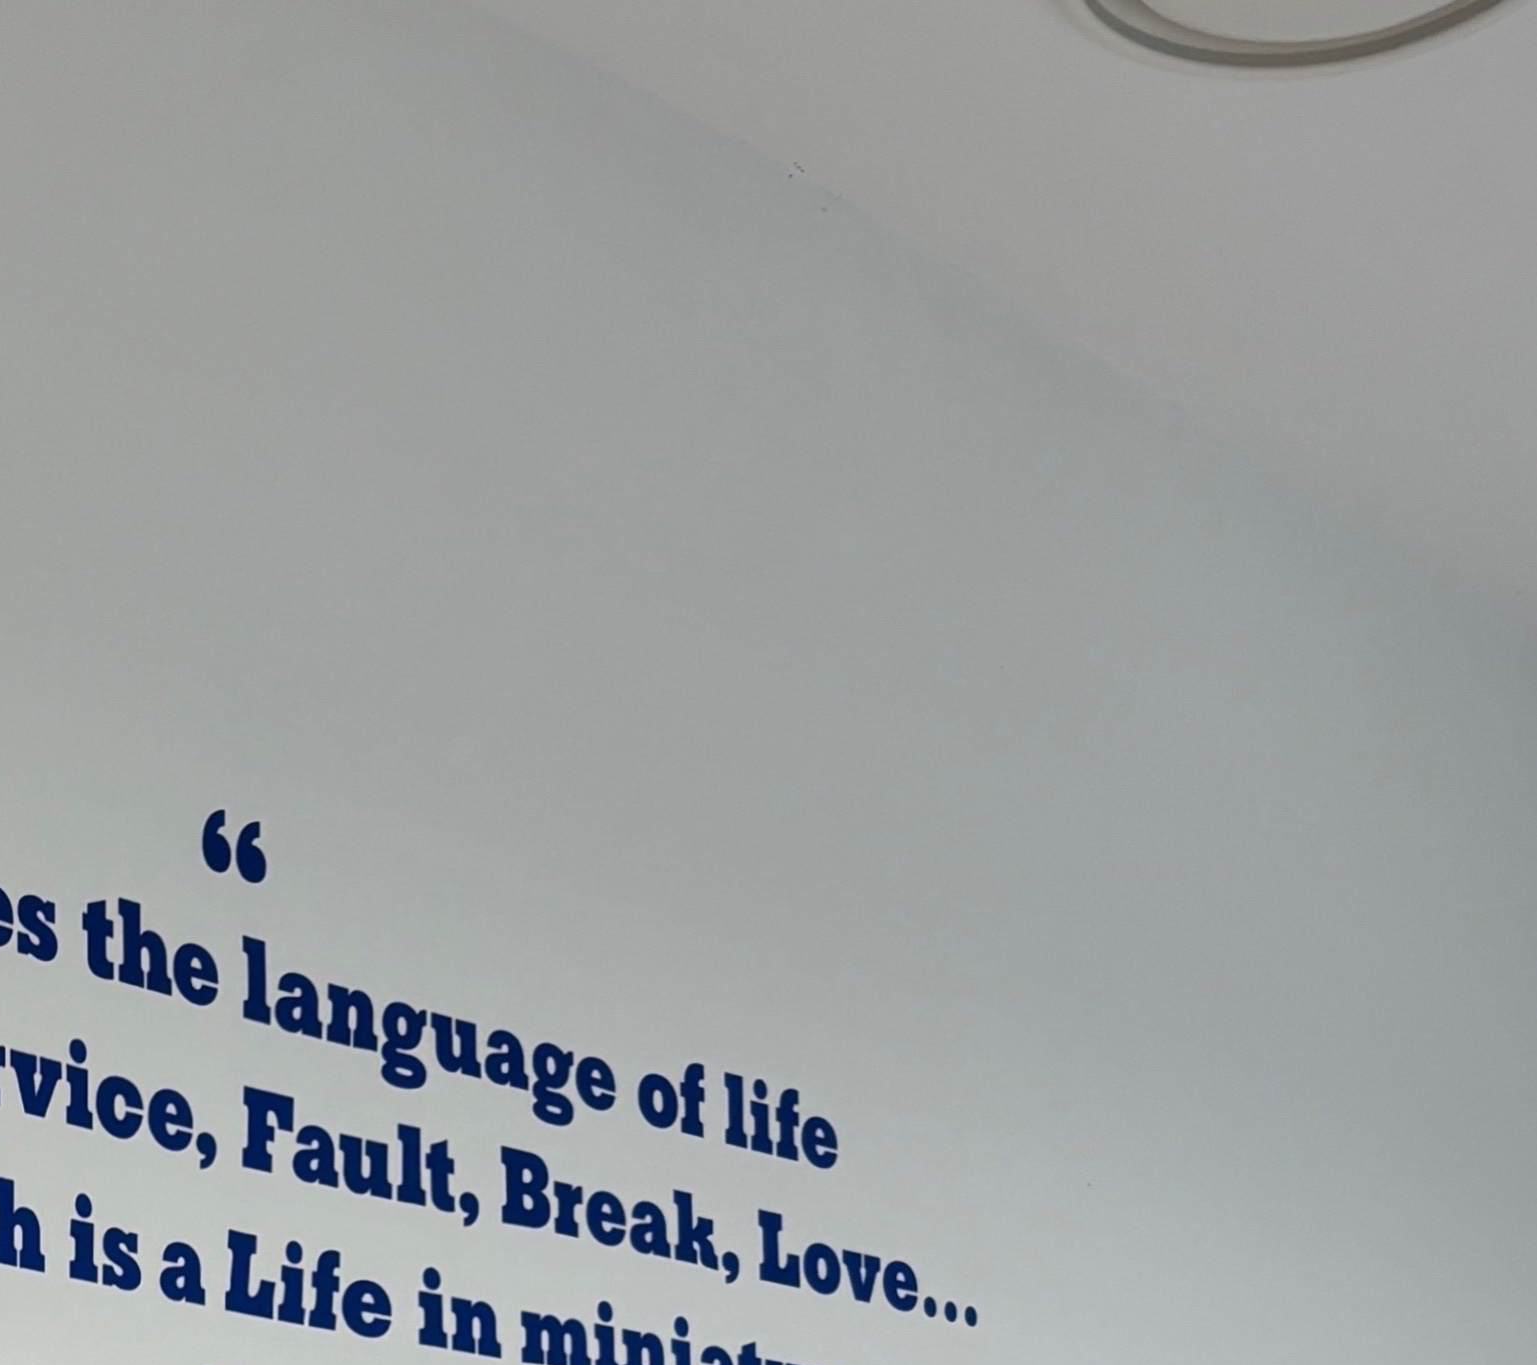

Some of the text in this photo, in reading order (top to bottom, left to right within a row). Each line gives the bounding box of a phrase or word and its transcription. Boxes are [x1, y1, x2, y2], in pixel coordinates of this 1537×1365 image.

[81, 899, 219, 1007] the
[241, 936, 616, 1127] language
[636, 1061, 705, 1138] of
[723, 1072, 839, 1170] life
[67, 1192, 143, 1293] is
[158, 1240, 207, 1307] a
[223, 1229, 394, 1340] Life
[417, 1266, 503, 1360] in
[241, 1085, 481, 1227] Fault,
[499, 1146, 741, 1283] Break,
[756, 1208, 979, 1328] Love...
